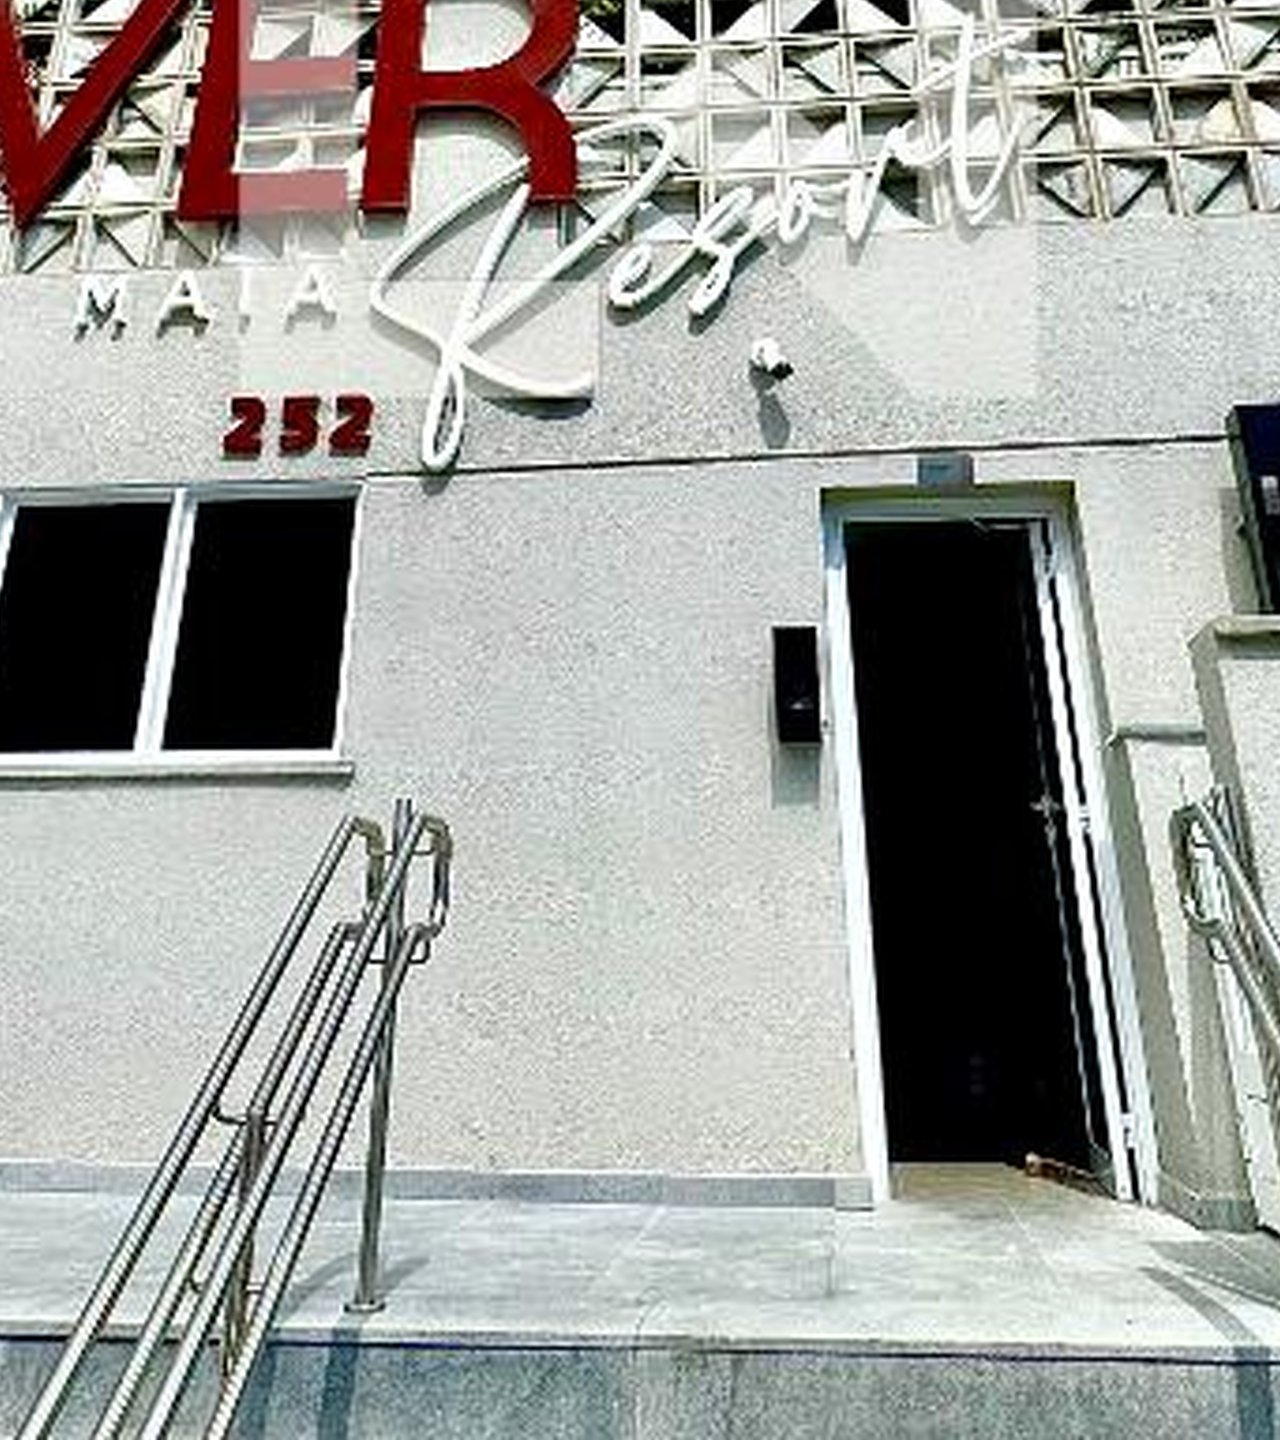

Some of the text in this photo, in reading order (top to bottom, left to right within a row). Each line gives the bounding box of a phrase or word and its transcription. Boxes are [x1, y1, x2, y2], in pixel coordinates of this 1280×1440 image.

[370, 12, 1032, 472] Resort
[75, 268, 340, 336] MAIA
[222, 396, 375, 458] 252
